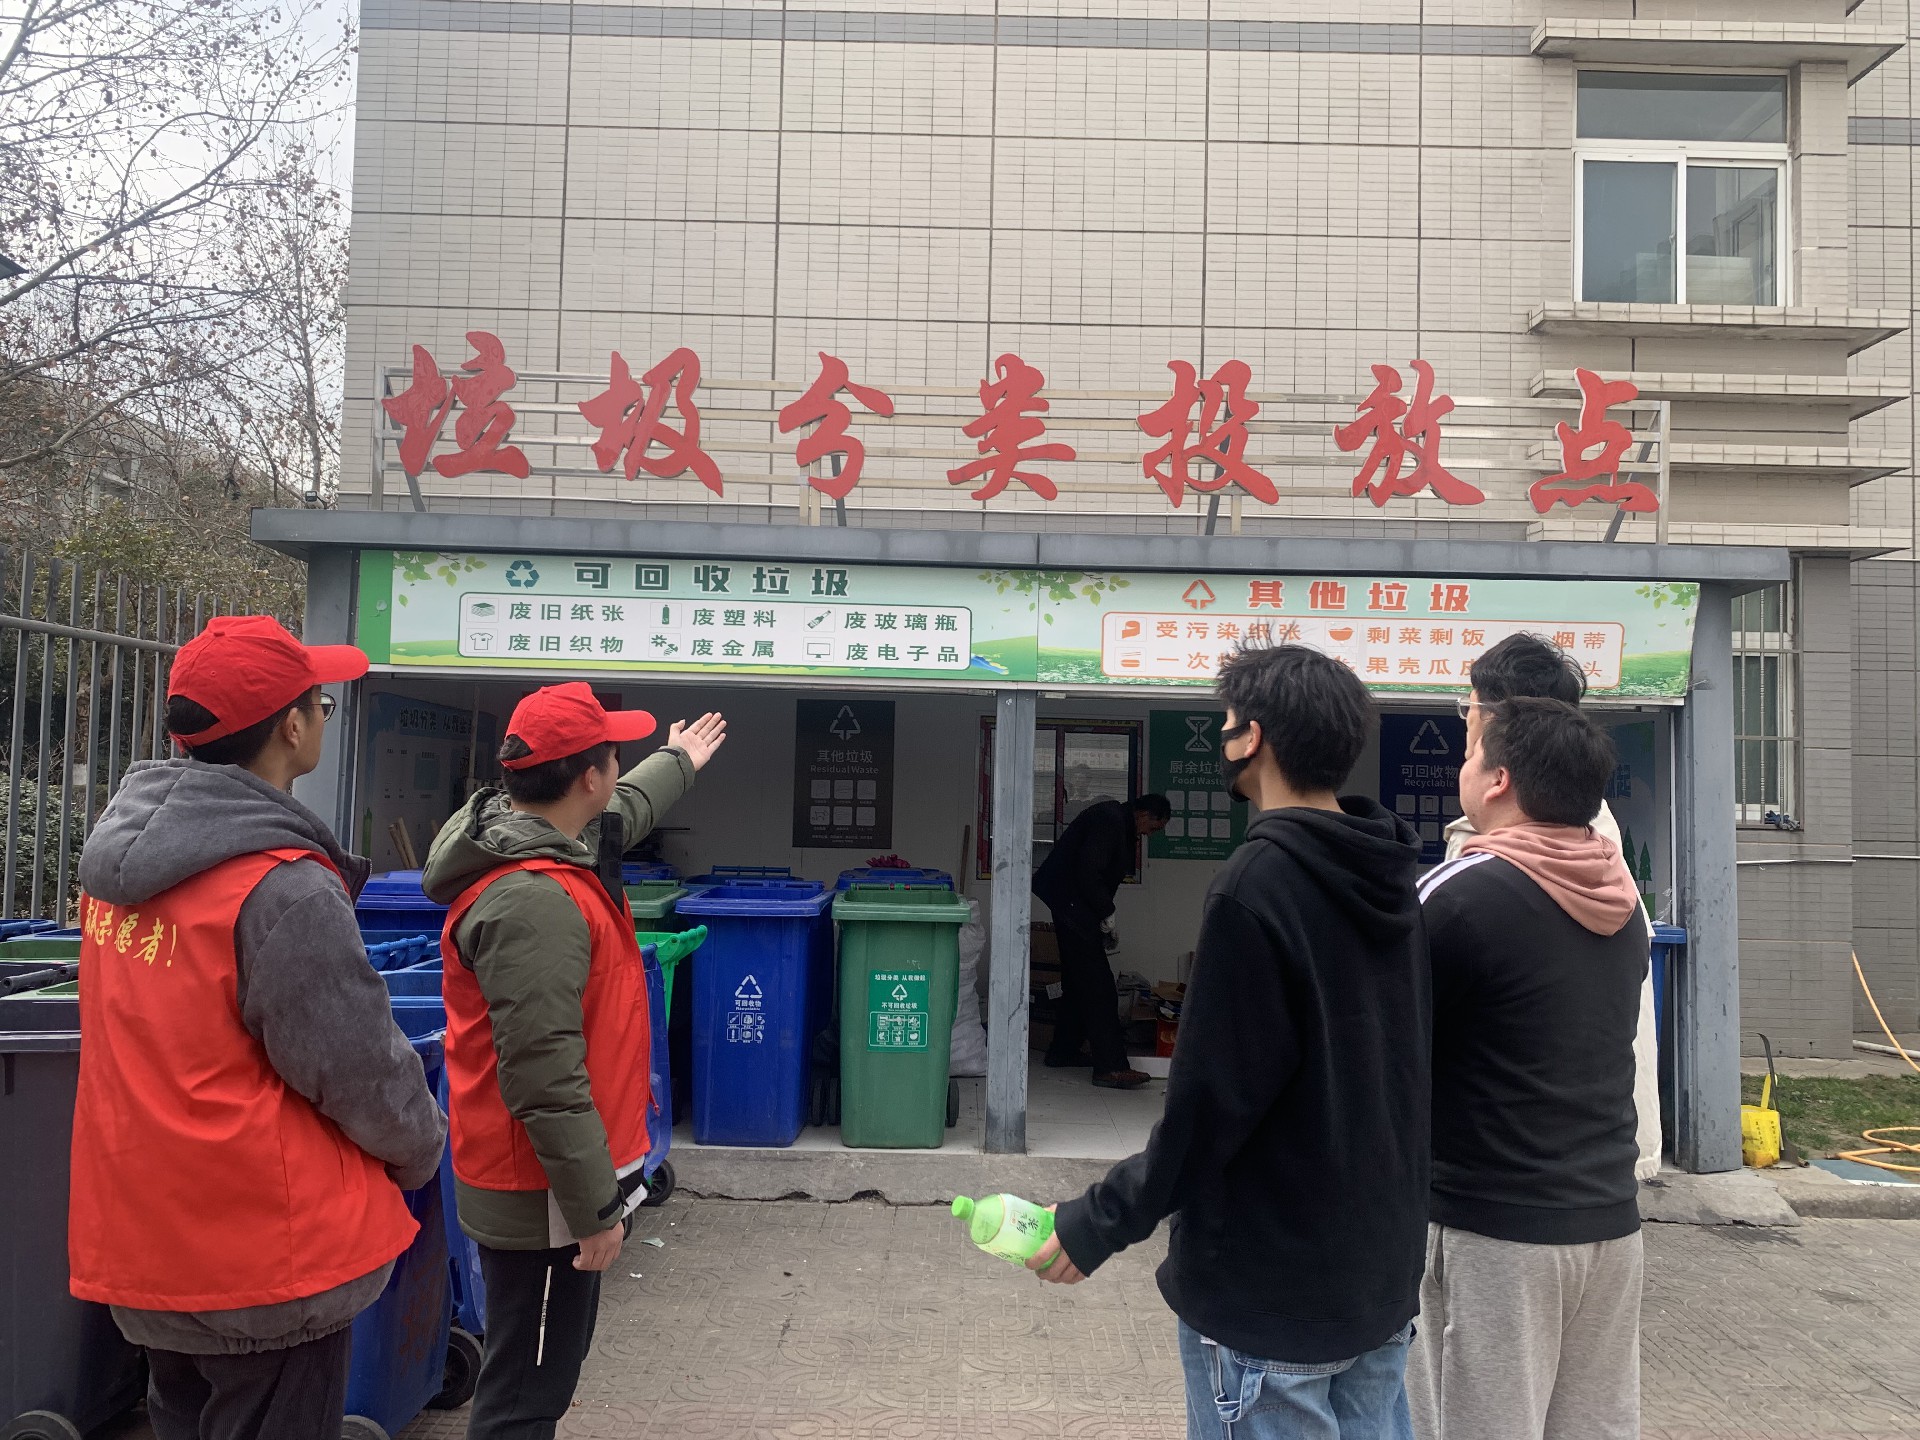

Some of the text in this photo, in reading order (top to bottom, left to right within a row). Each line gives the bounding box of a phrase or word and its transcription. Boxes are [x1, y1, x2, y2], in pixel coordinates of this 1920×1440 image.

[382, 331, 1660, 514] 垃圾分类投放点
[573, 562, 849, 597] 可回收垃圾
[1248, 580, 1470, 612] 其他垃圾
[509, 602, 625, 622] 废旧纸张
[692, 608, 777, 628] 废塑料
[844, 611, 958, 632] 废玻璃瓶
[1156, 621, 1301, 641] 受污染纸张
[1367, 627, 1485, 646] 剩菜剩饭
[507, 633, 624, 653] 废旧织物
[690, 638, 775, 658] 废金属
[846, 642, 959, 662] 废电子品
[816, 750, 873, 764] 其他垃圾
[810, 765, 879, 775] Residual Waste
[1400, 764, 1459, 779] 可回收物
[1172, 776, 1196, 786] Food
[1404, 778, 1455, 789] Recyclable
